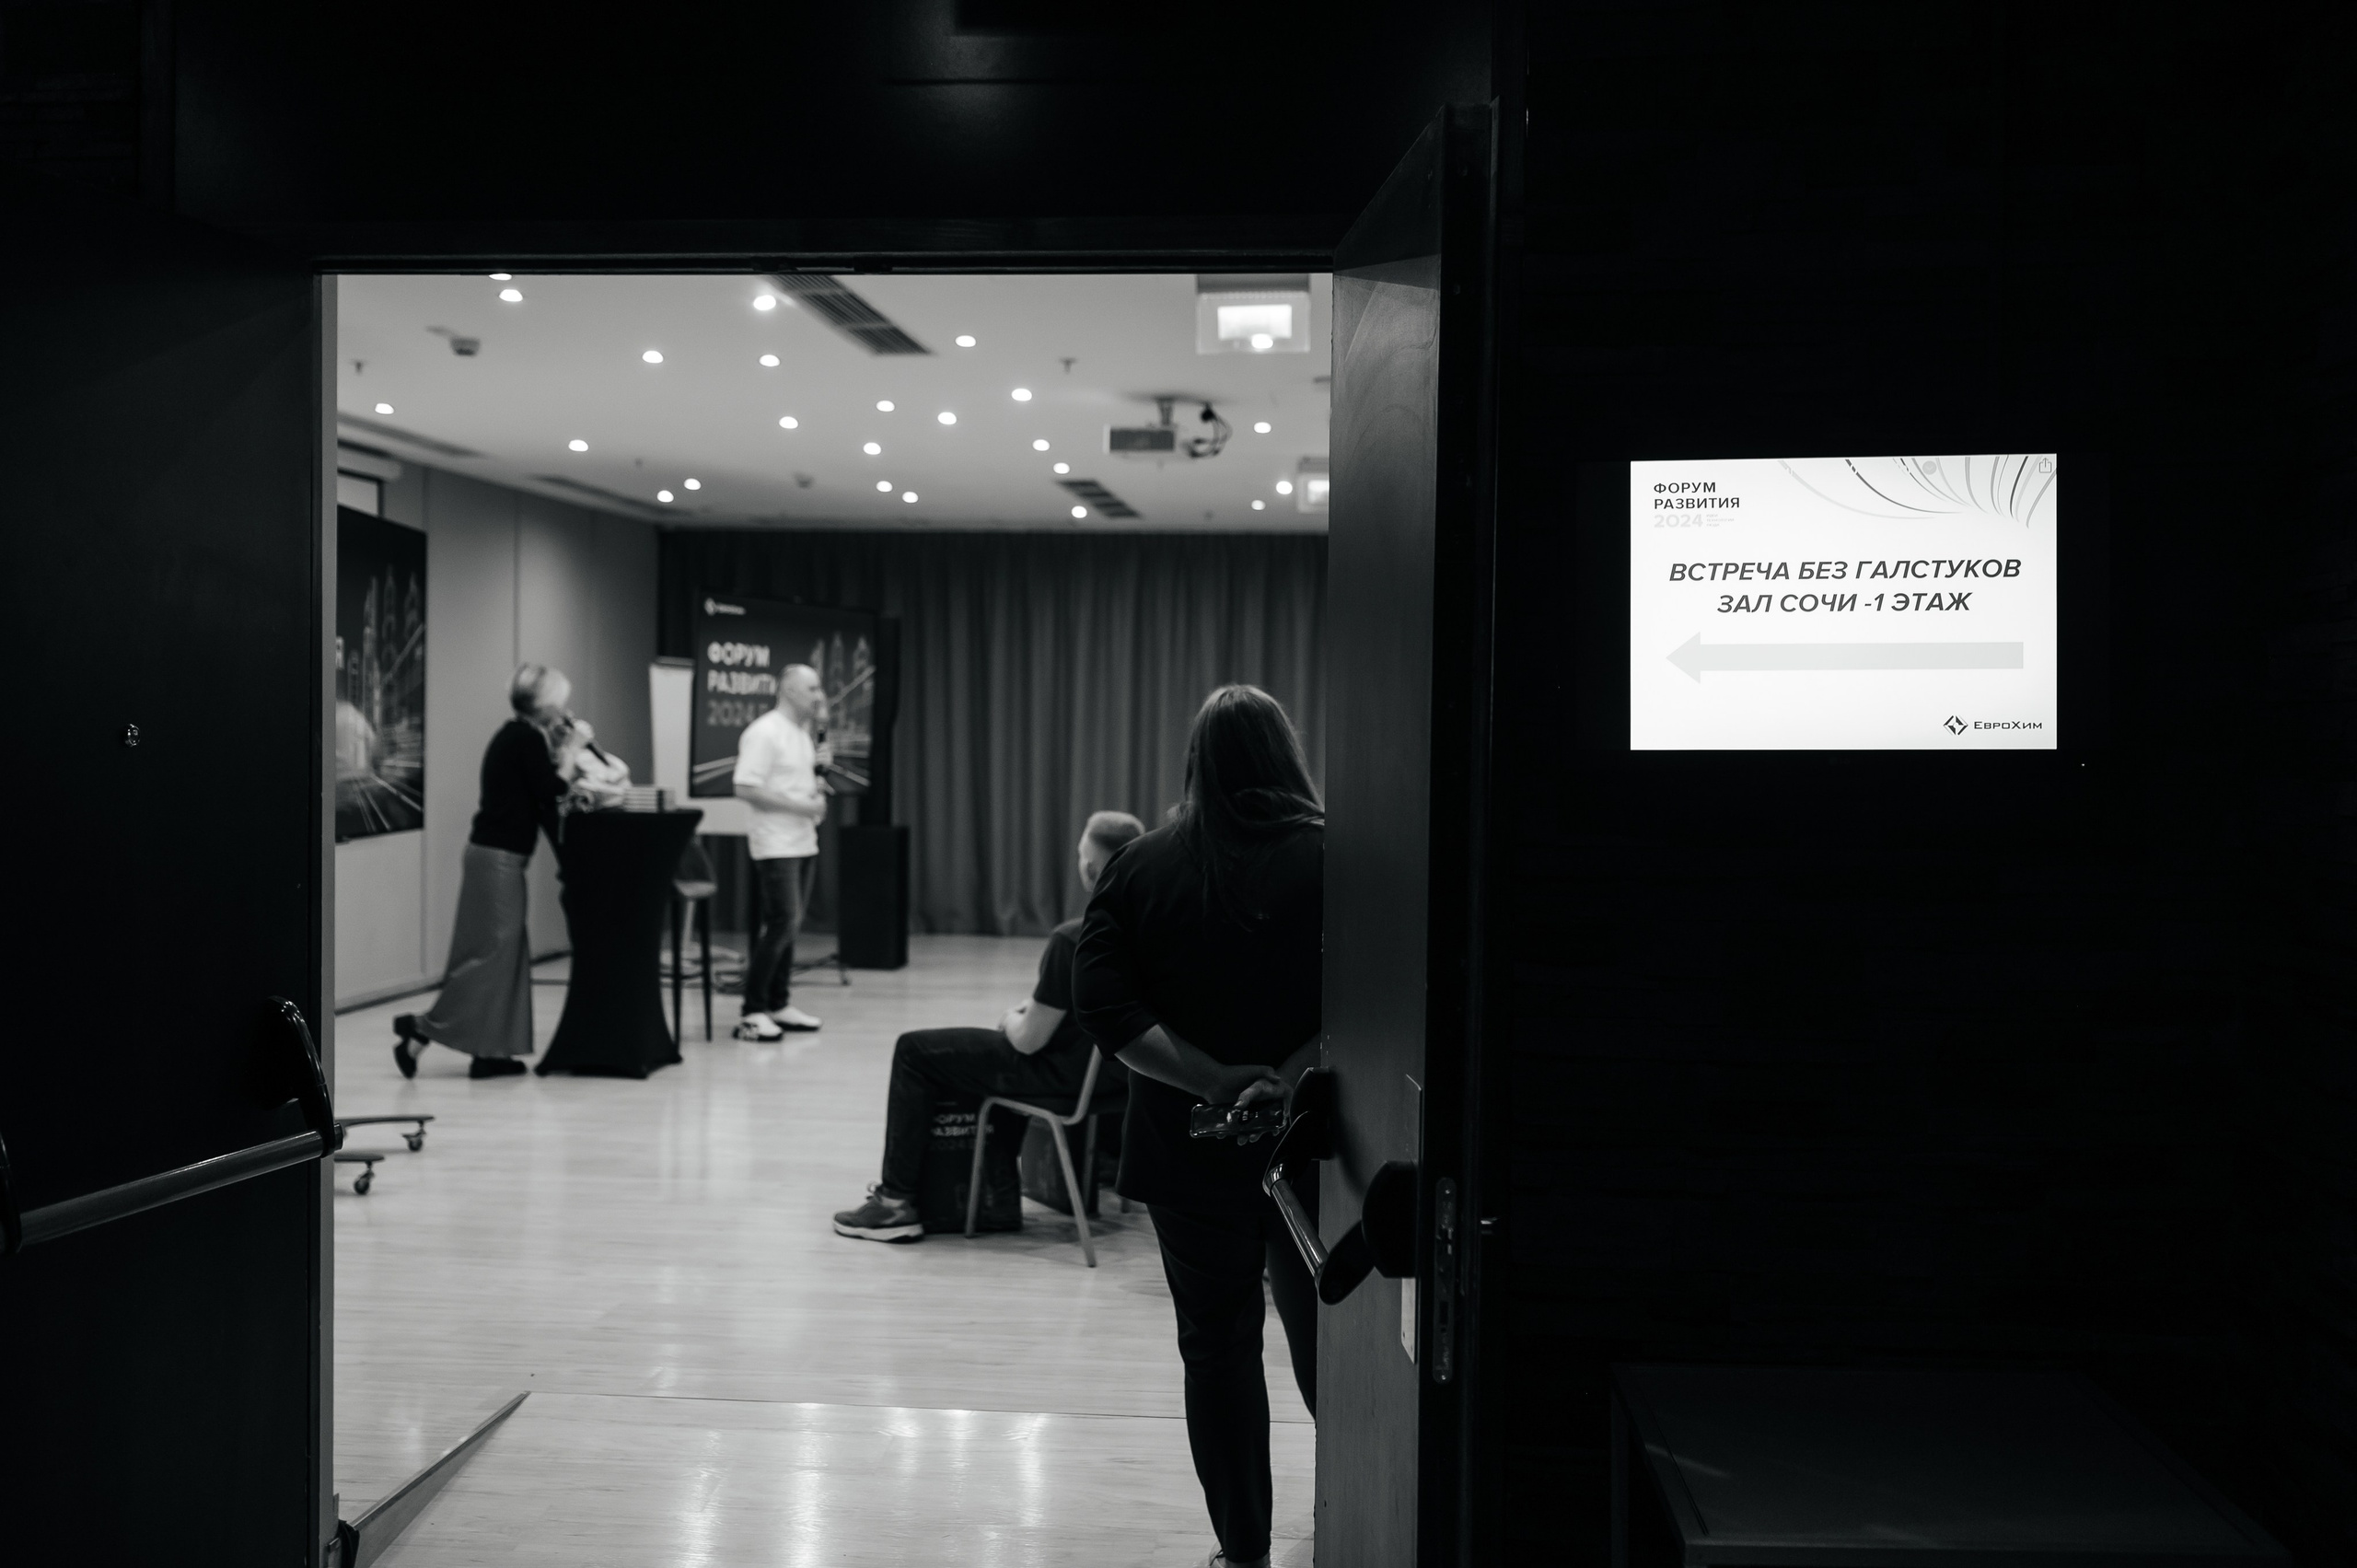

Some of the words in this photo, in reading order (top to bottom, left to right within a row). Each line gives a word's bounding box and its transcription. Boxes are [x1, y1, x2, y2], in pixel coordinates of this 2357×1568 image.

[1653, 482, 1716, 494] ФОРУМ
[1654, 497, 1740, 510] РАЗВИТИЯ
[1654, 514, 1702, 528] 2024
[1669, 562, 1790, 582] ВСТРЕЧА
[1798, 561, 1849, 580] БЕЗ
[1855, 559, 2022, 579] ГАЛСТУКОВ
[1717, 594, 1773, 613] ЗАЛ
[1780, 593, 1858, 612] СОЧИ
[1864, 593, 1885, 611] -1
[1890, 592, 1973, 611] ЭТАЖ
[707, 641, 771, 668] ФОРУМ
